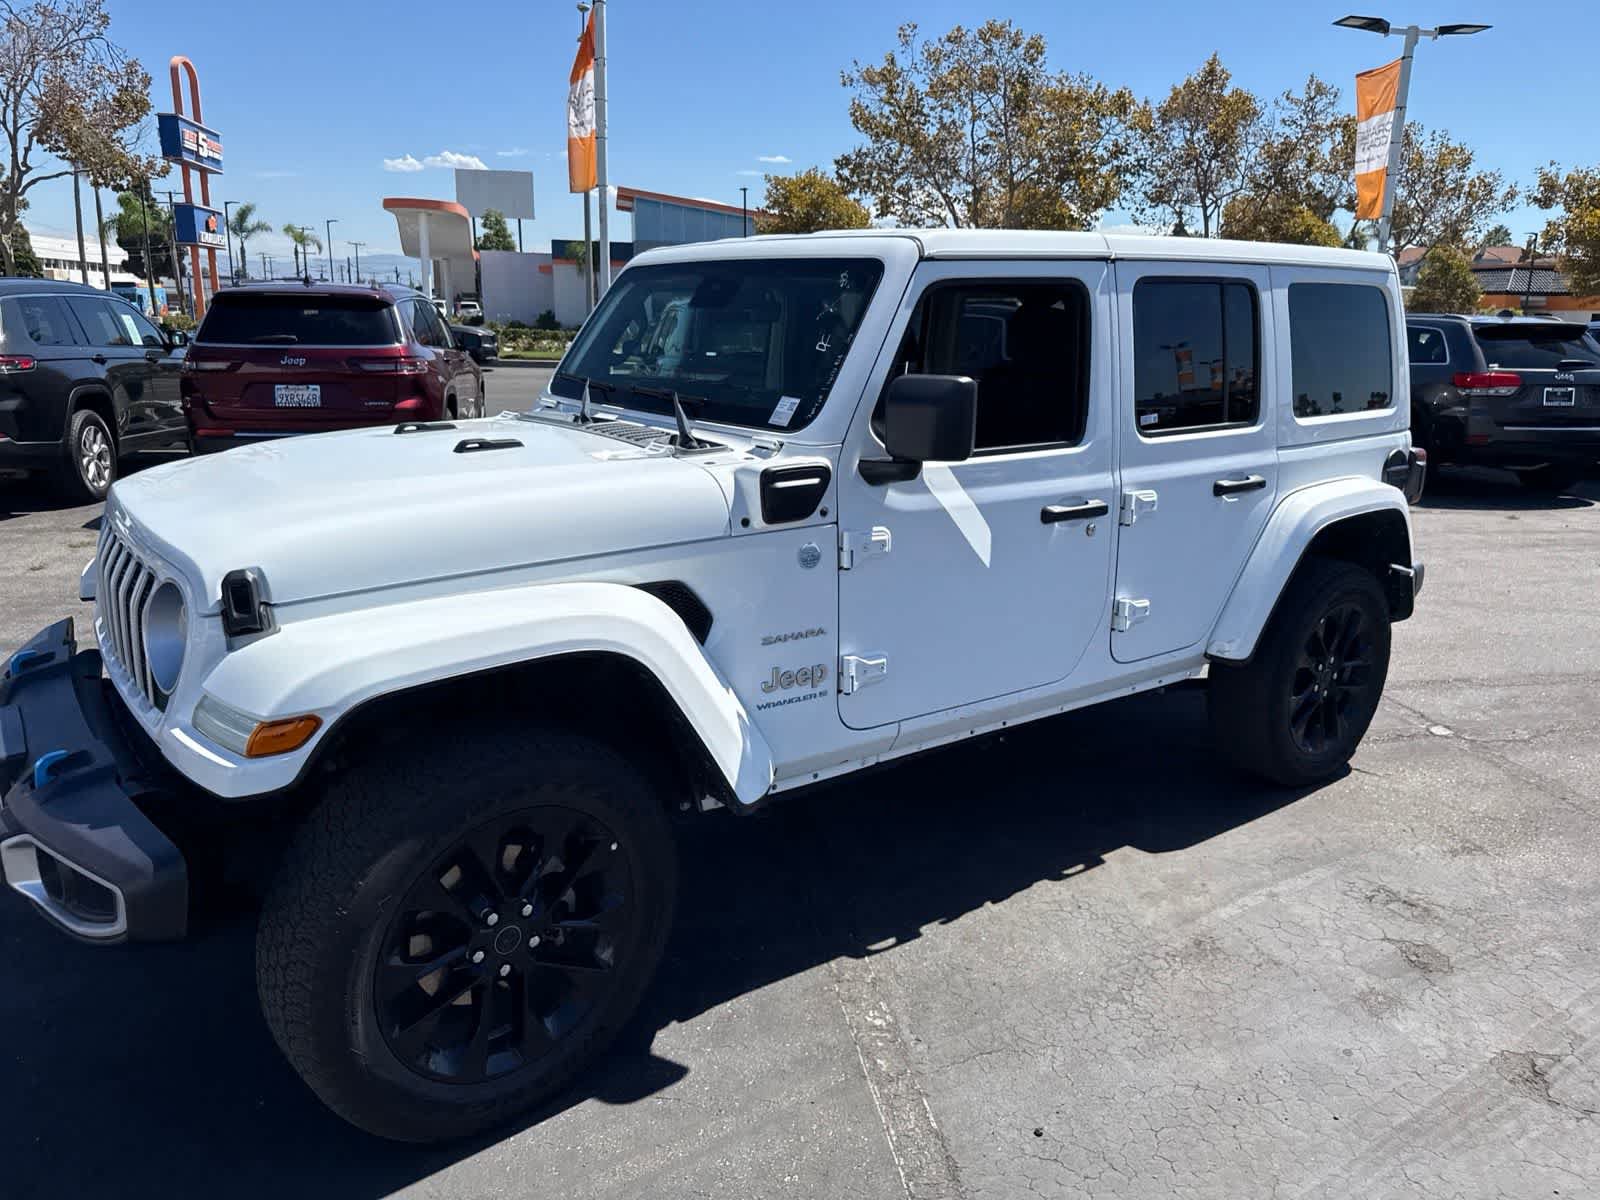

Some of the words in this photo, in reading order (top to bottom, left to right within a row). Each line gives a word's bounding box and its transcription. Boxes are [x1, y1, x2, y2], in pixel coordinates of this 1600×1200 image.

[198, 131, 209, 158] 5
[280, 355, 306, 367] Jeep
[760, 627, 827, 646] SAHARA
[760, 663, 828, 694] Jeep
[756, 692, 817, 711] WRANGLER
